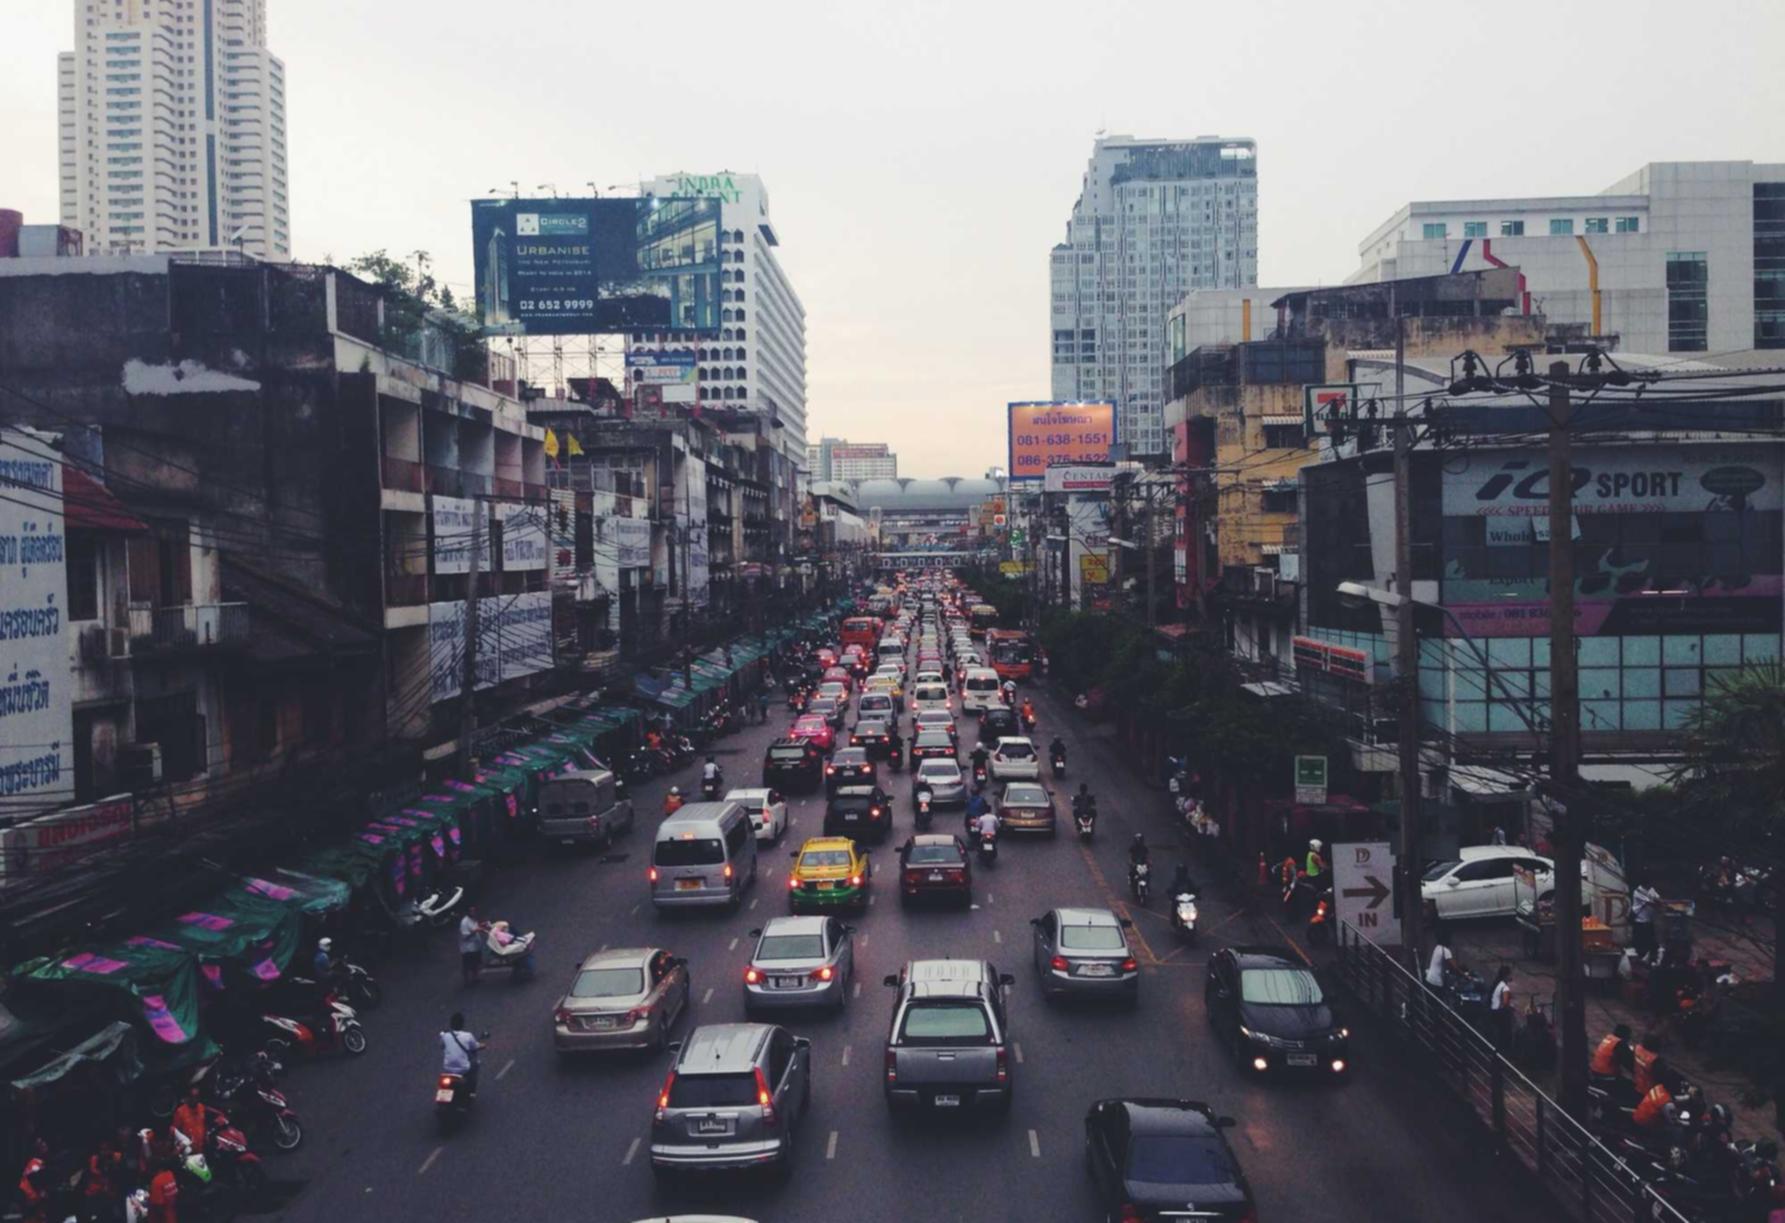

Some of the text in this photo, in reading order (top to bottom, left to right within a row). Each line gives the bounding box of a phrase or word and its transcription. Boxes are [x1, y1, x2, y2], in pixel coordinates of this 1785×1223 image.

[678, 176, 734, 190] INDRA
[520, 300, 594, 310] 02 652 9999
[1016, 433, 1108, 446] 081-638-1551
[1597, 472, 1683, 498] SPORT
[1358, 912, 1378, 928] IN
